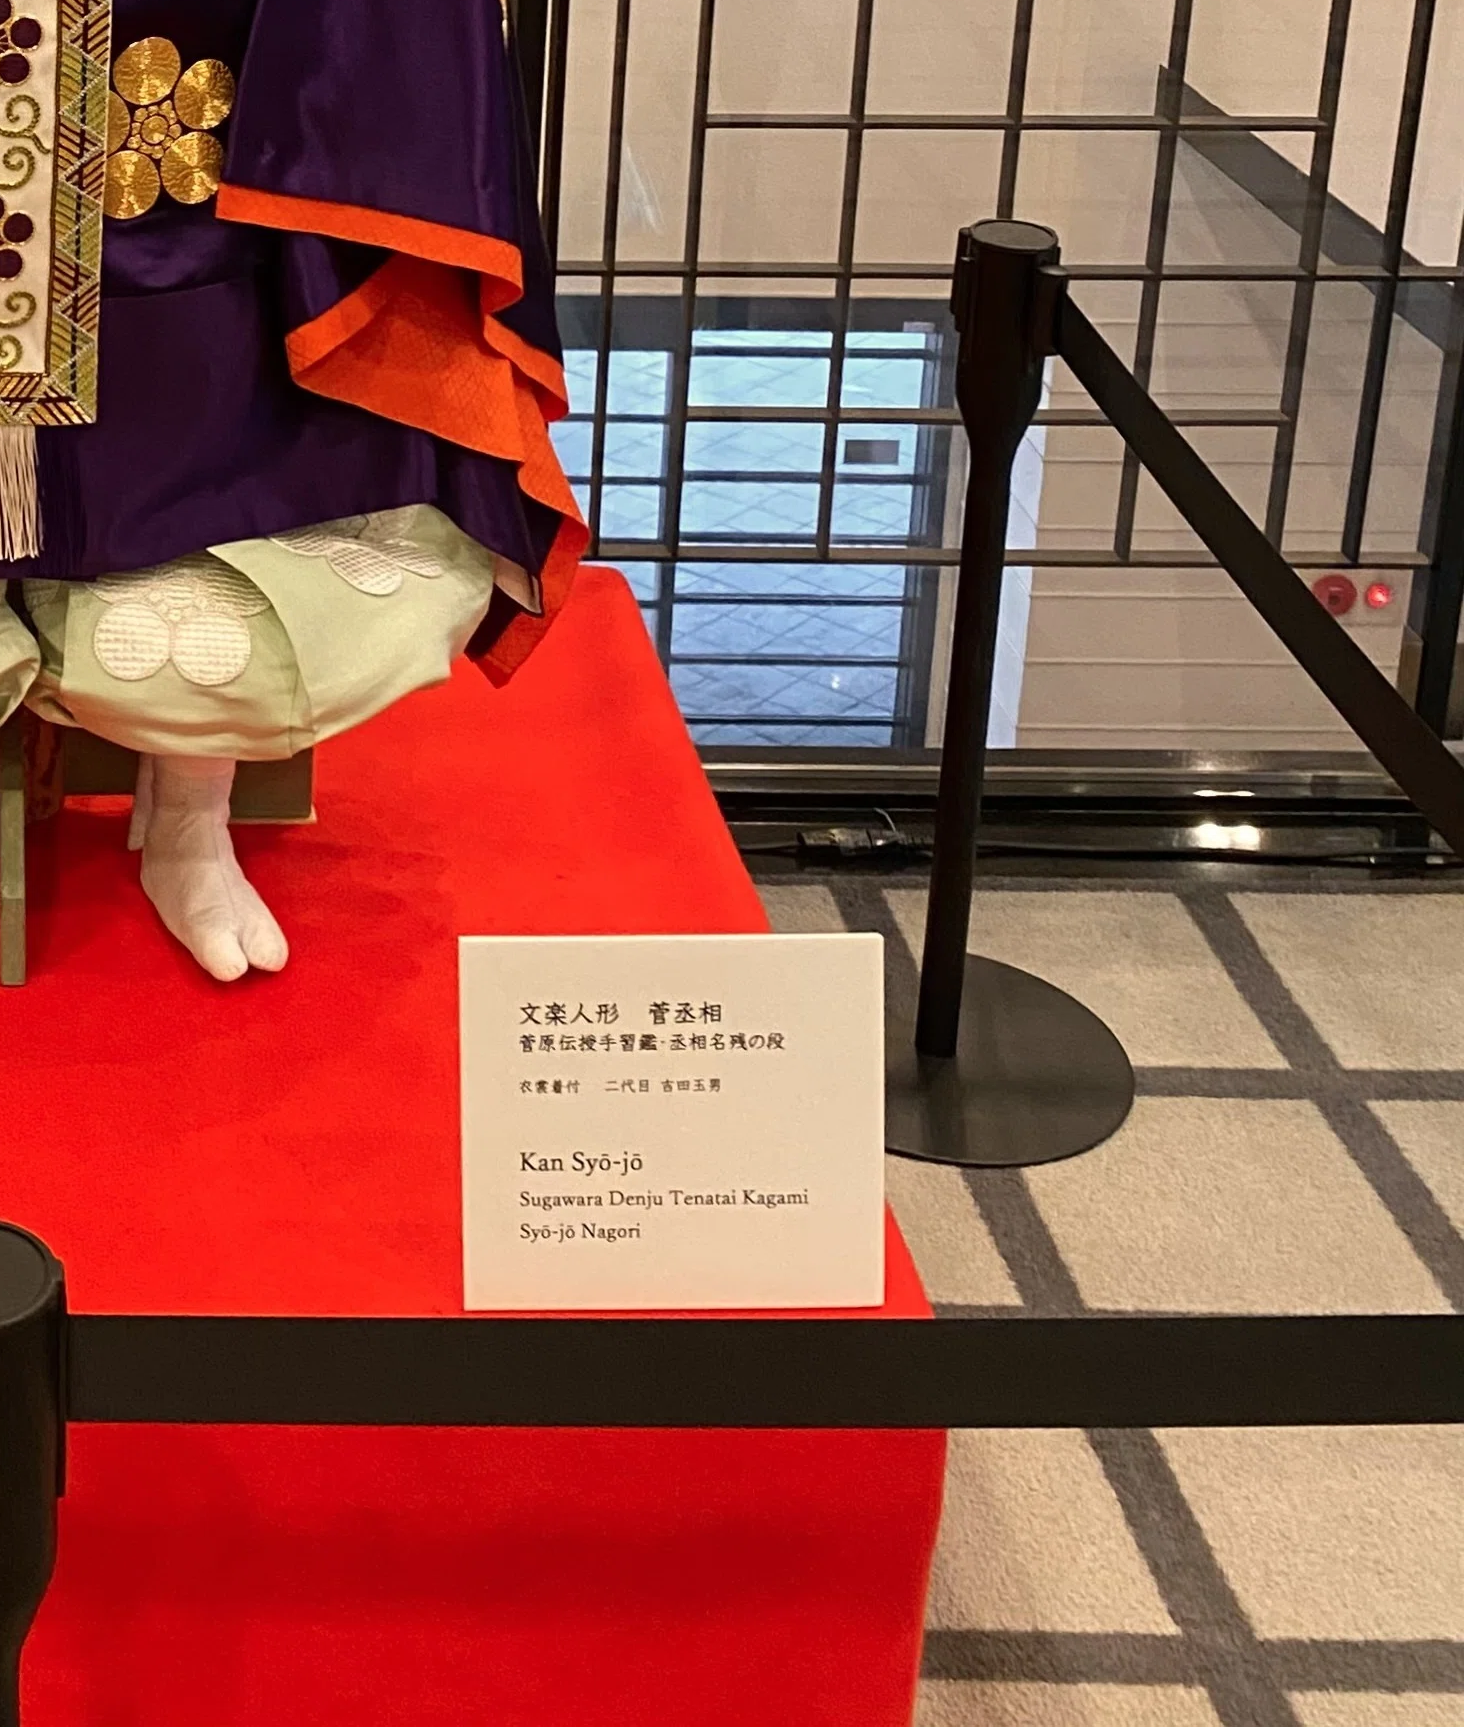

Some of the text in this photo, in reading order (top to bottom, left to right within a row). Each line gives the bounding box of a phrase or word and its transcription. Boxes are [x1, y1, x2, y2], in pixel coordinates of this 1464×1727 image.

[519, 1001, 722, 1025] 文楽人形 菅丞相
[604, 1079, 649, 1093] 二代目
[519, 1151, 643, 1176] Kan Syō-jō
[519, 1189, 809, 1211] Sugawara Denju Tenatai Kagami
[519, 1222, 641, 1243] Syō-jō Nagori
